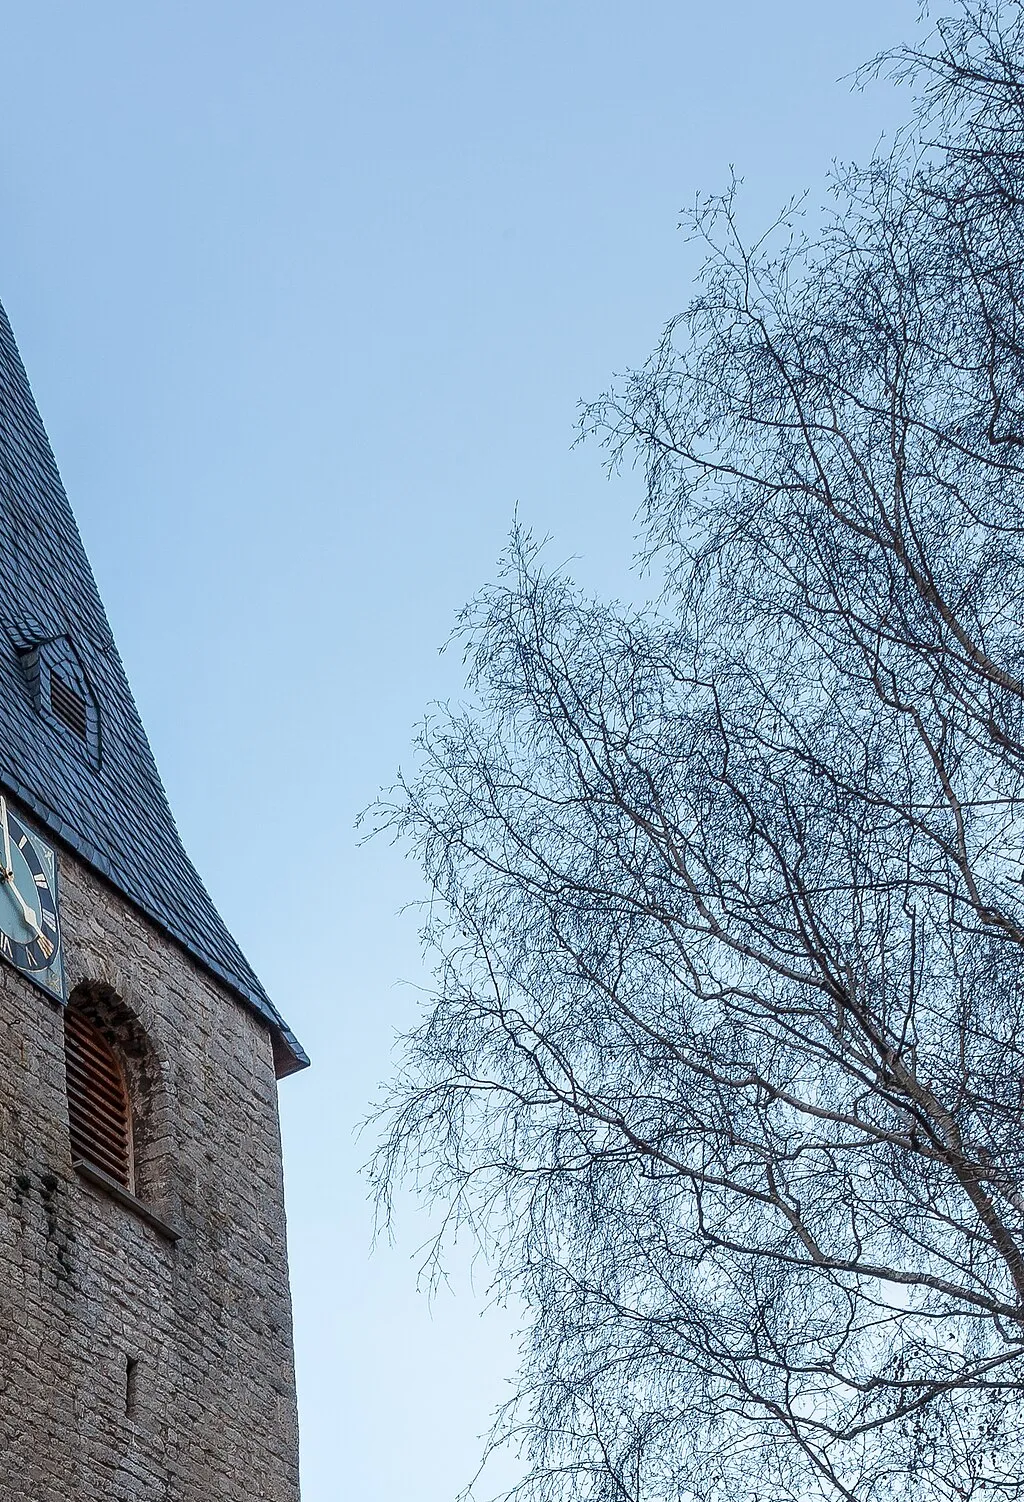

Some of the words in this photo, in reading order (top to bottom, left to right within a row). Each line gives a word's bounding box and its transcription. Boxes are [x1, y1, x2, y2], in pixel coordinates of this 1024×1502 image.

[18, 834, 28, 850] I
[33, 873, 49, 890] II
[42, 907, 57, 933] III
[0, 931, 13, 959] VI
[36, 936, 55, 960] IIII
[25, 946, 38, 967] V
